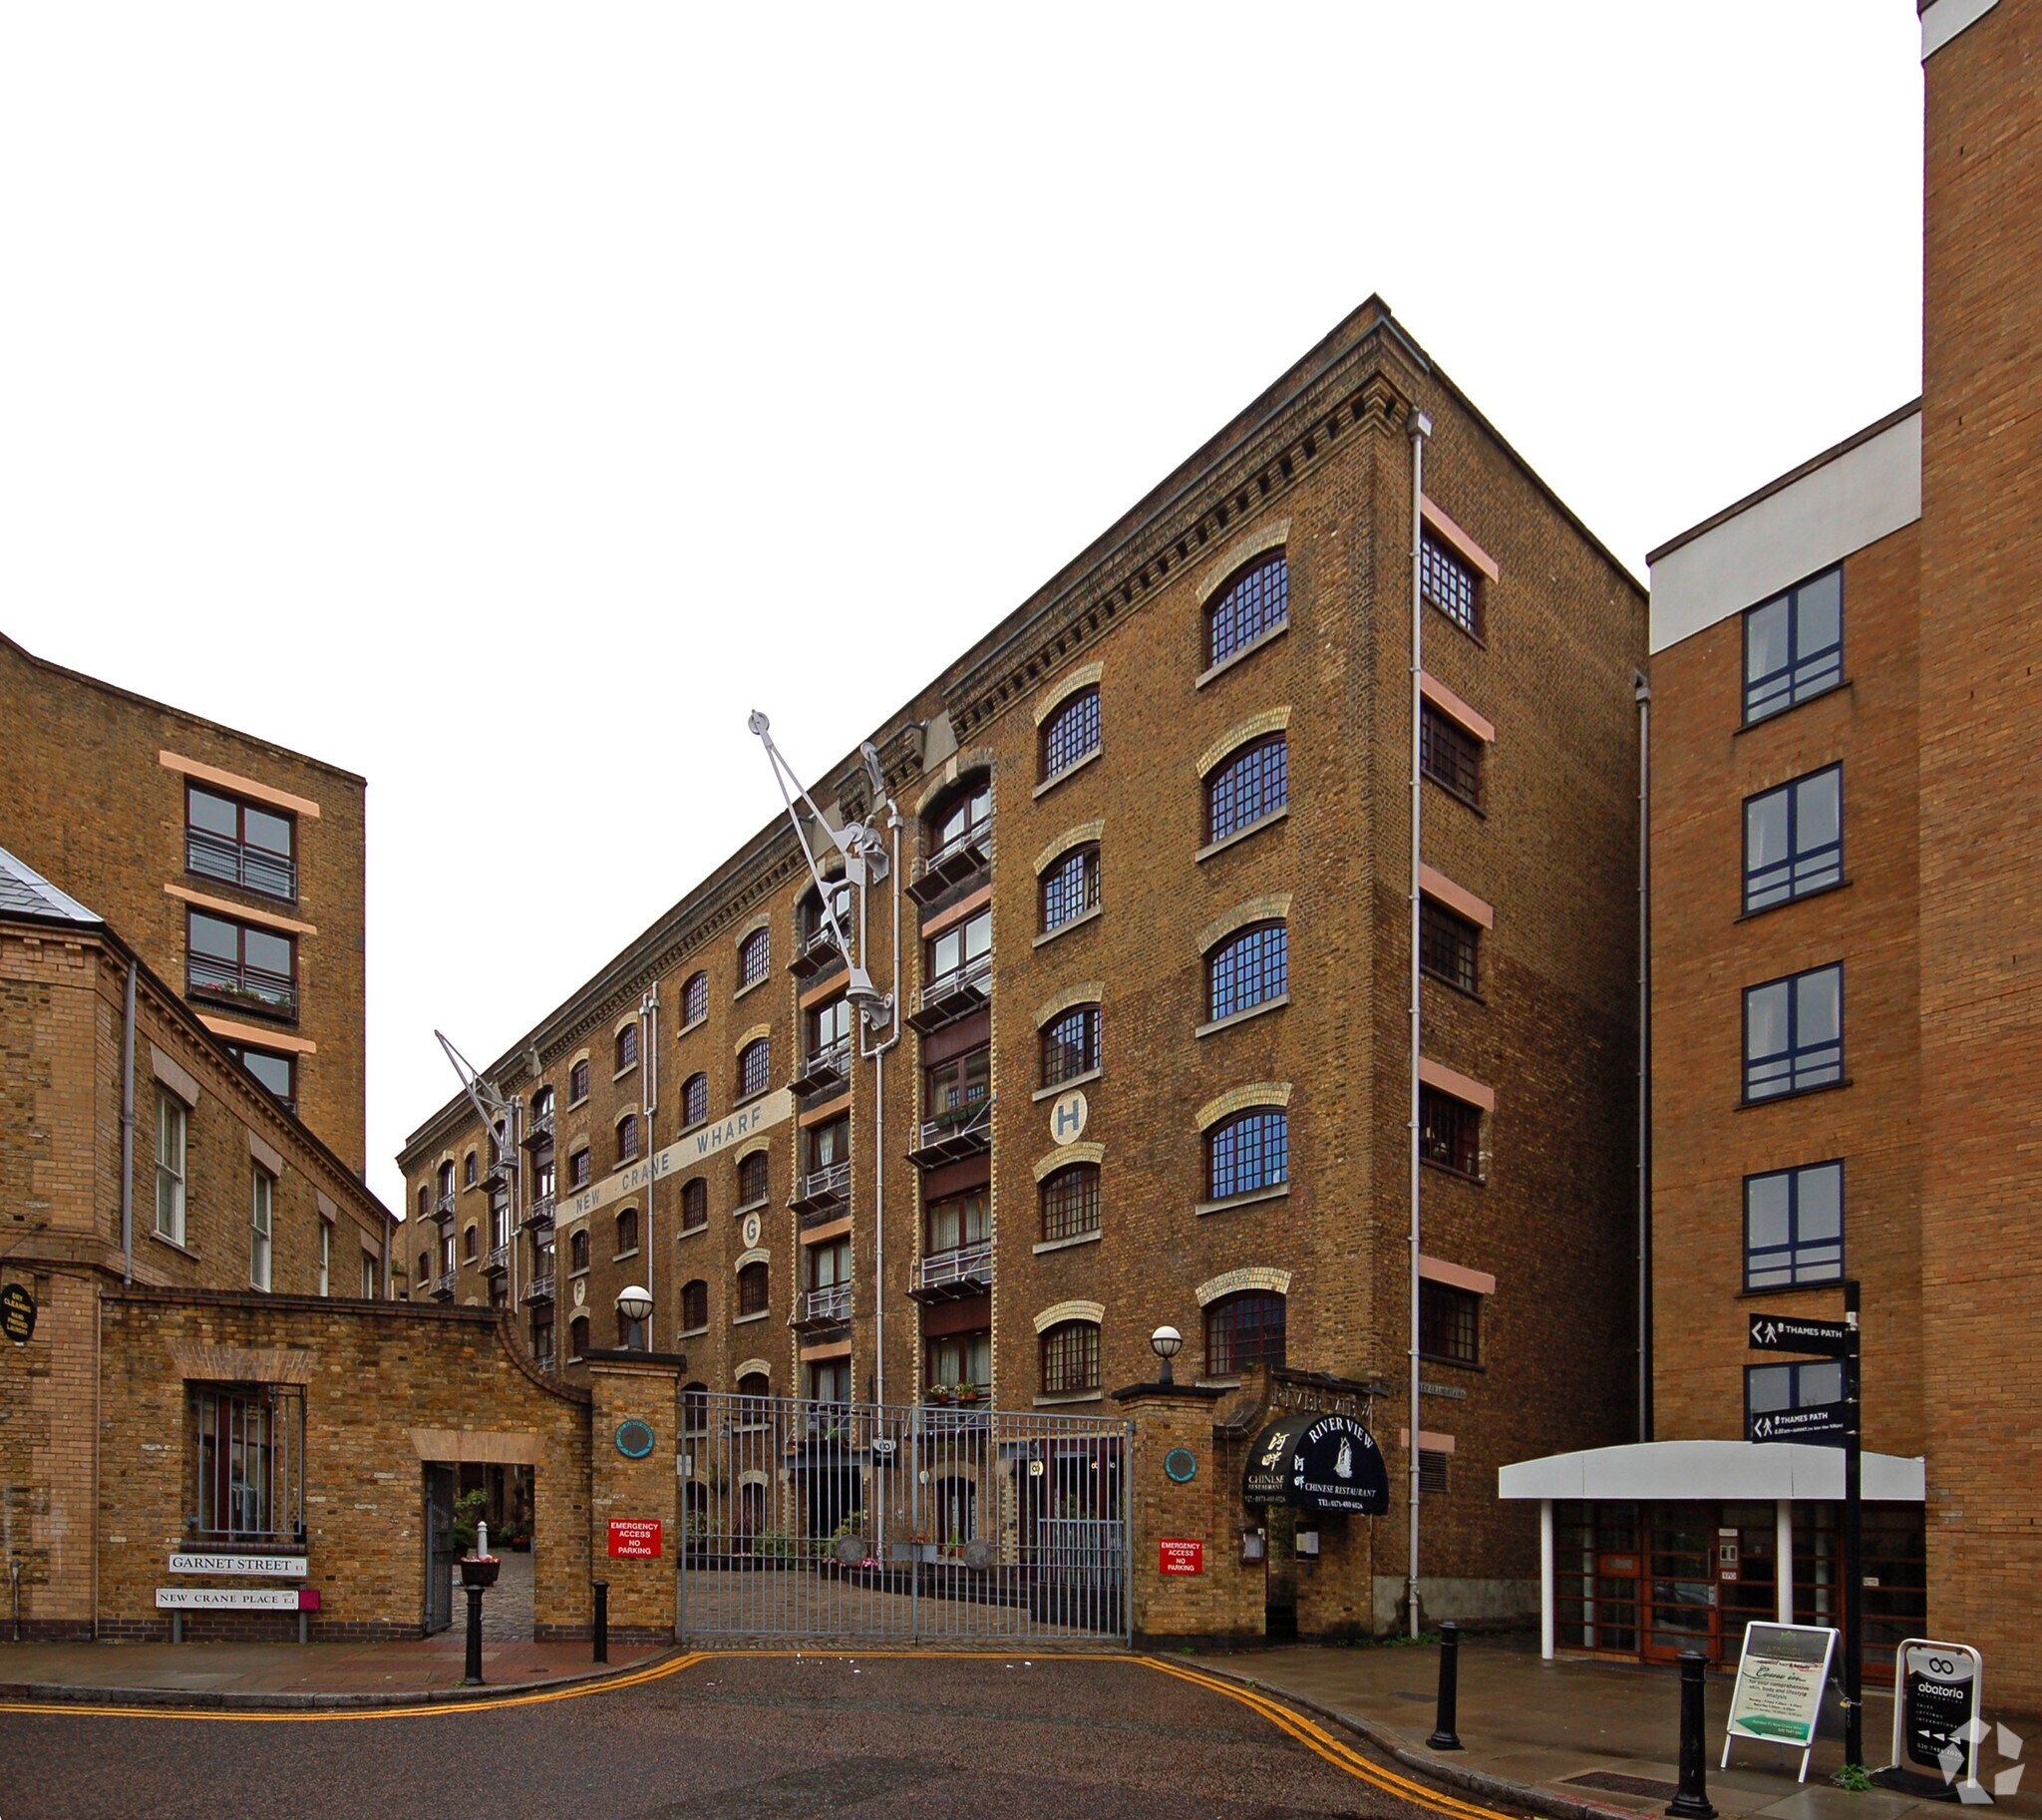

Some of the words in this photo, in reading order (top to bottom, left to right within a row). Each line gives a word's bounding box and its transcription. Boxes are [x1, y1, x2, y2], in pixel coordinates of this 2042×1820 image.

[1058, 1099, 1079, 1136] H
[575, 1190, 600, 1214] NEW
[622, 1153, 670, 1191] CRANE
[696, 1106, 761, 1154] WHARF
[746, 1219, 757, 1242] G
[1786, 1325, 1819, 1336] THAMES
[1821, 1329, 1843, 1338] PATH
[1273, 1387, 1322, 1411] RIVER
[1781, 1415, 1808, 1425] THAMES
[1809, 1412, 1829, 1421] PATH
[1308, 1417, 1344, 1444] RIVER
[1346, 1418, 1374, 1449] VIEW
[1248, 1475, 1284, 1484] CHINESE
[1304, 1482, 1334, 1494] CHINESE
[1334, 1484, 1376, 1498] RESTAURANT
[172, 1557, 234, 1569] GARNET
[237, 1559, 292, 1571] STREET
[160, 1594, 187, 1603] NEW
[193, 1595, 236, 1604] CRANE
[242, 1595, 278, 1604] PLACE
[1770, 1681, 1810, 1691] comprehensive
[1786, 1688, 1807, 1697] lifestyle
[1917, 1682, 1964, 1699] abatoria
